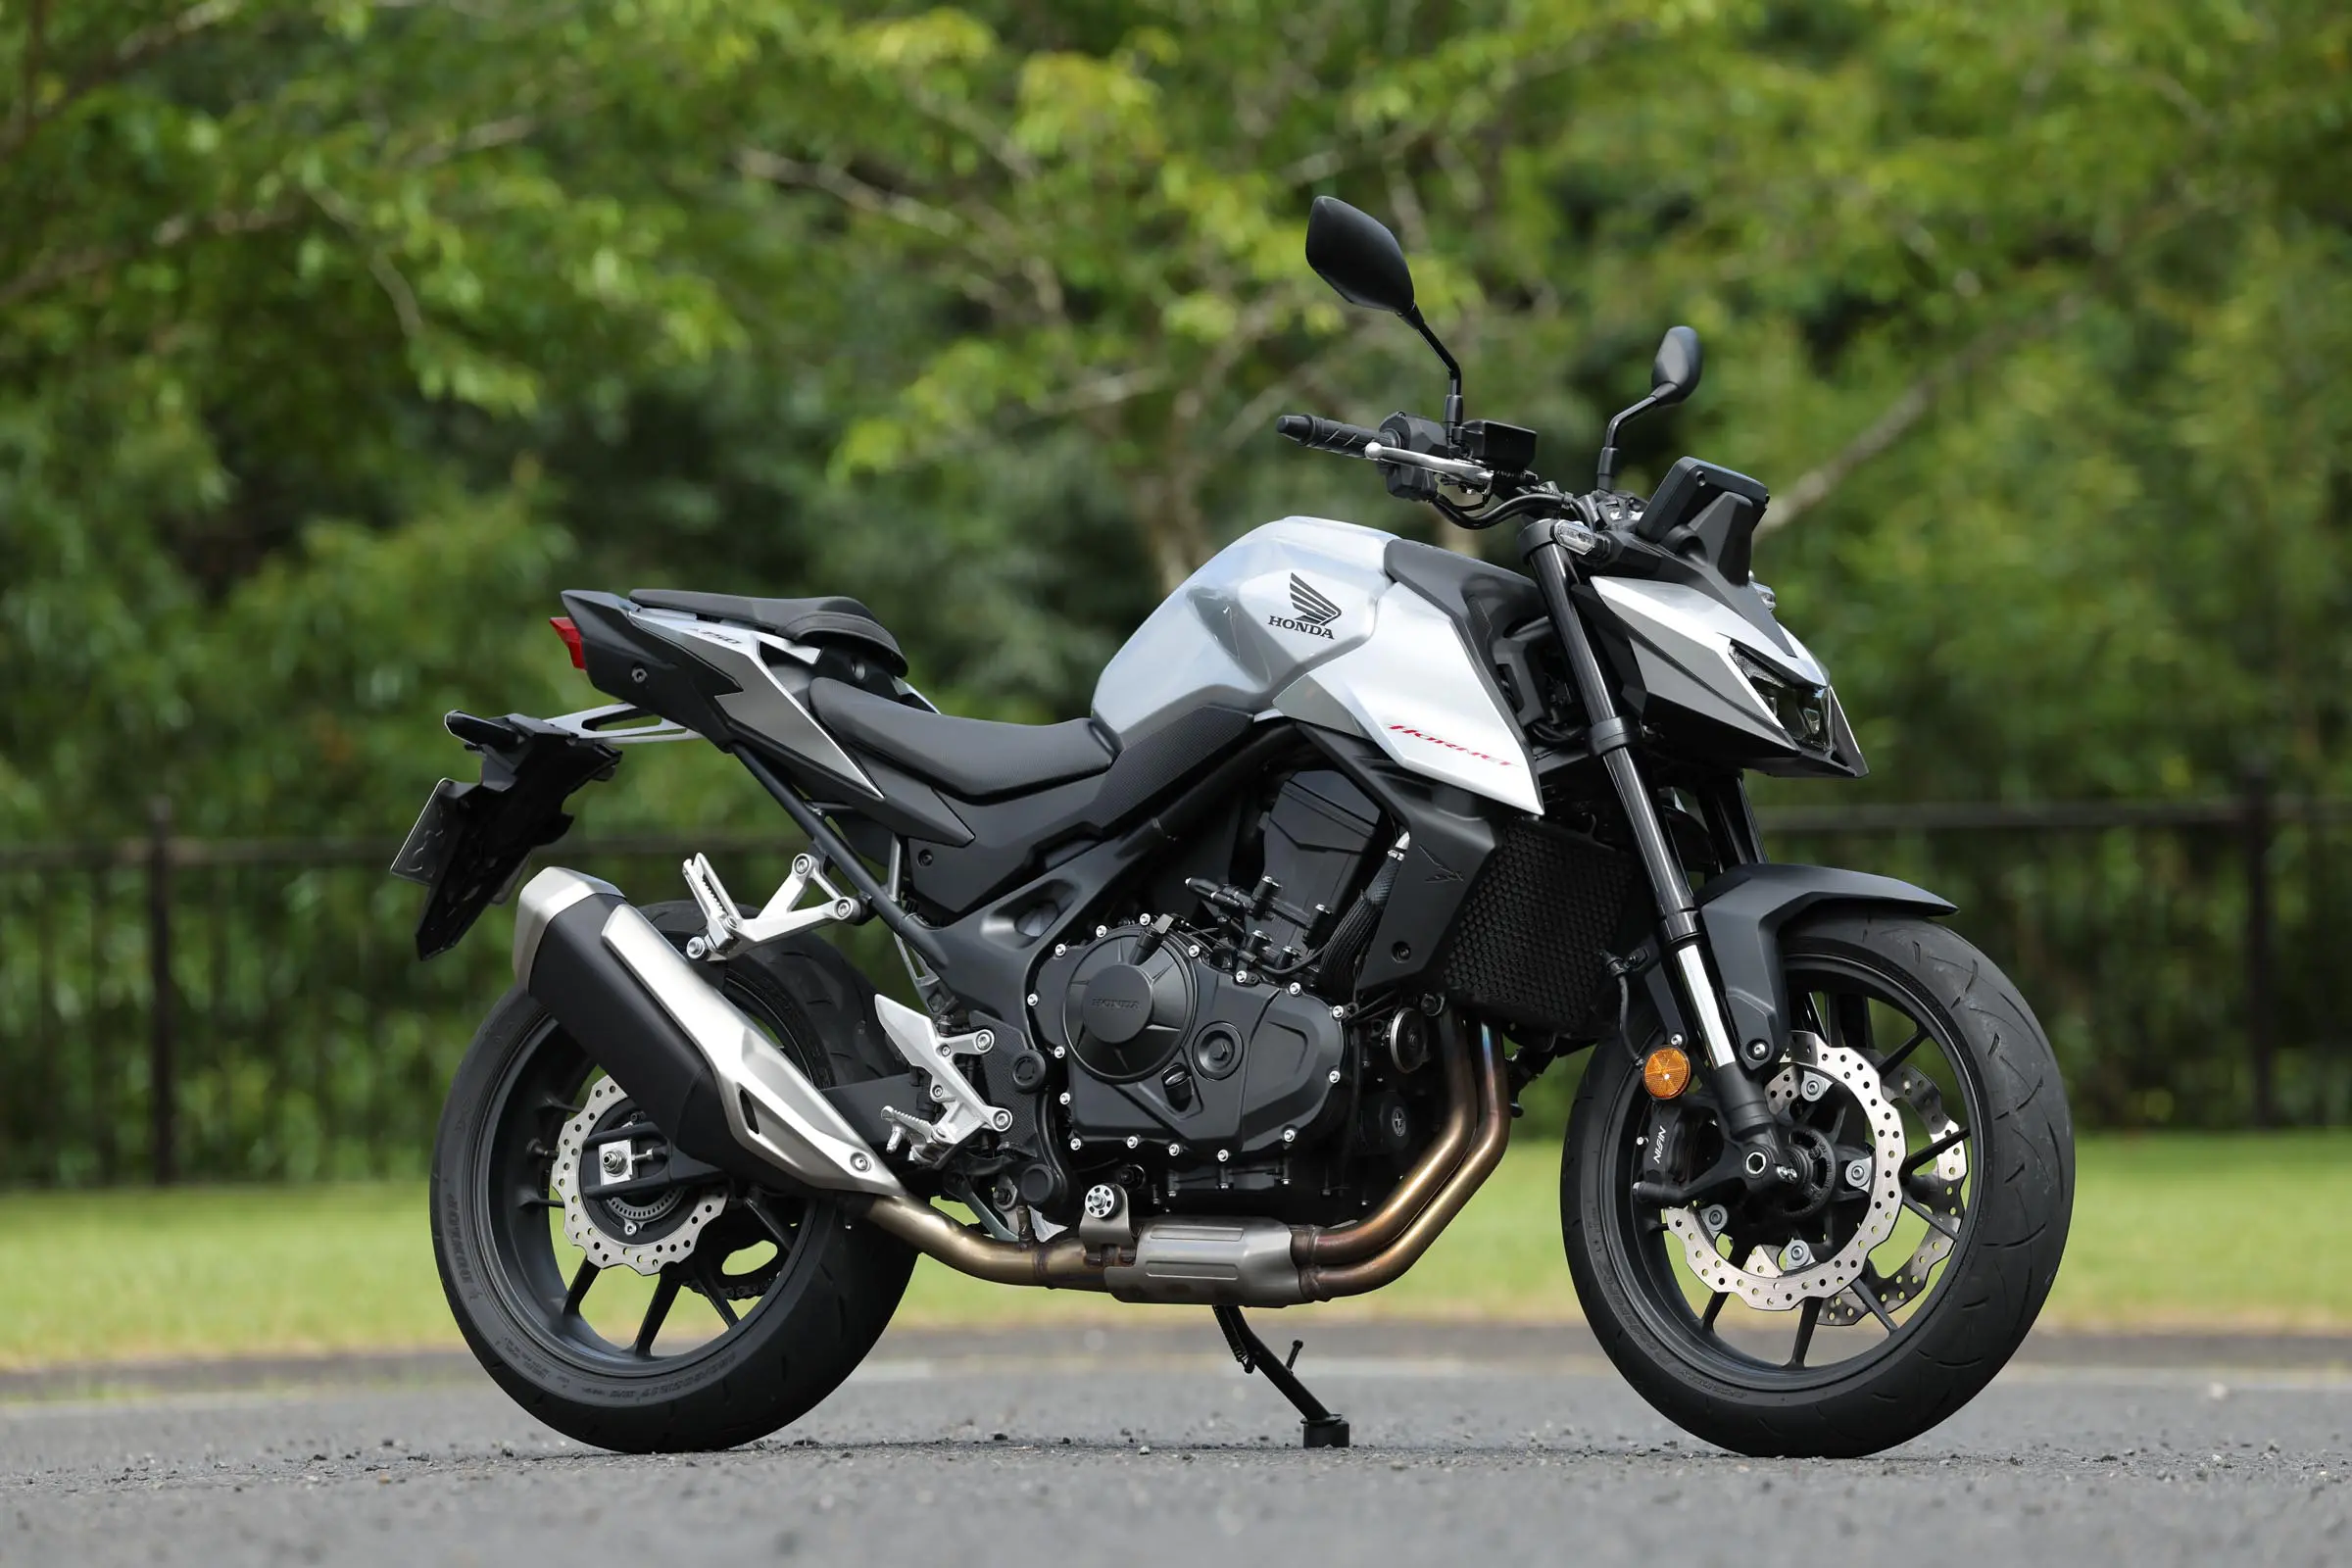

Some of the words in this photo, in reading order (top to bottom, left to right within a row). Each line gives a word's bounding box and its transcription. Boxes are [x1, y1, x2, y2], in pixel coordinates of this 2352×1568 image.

[1268, 615, 1335, 640] HONDA
[1092, 998, 1142, 1010] HONDA
[1653, 1125, 1666, 1164] NISSIN
